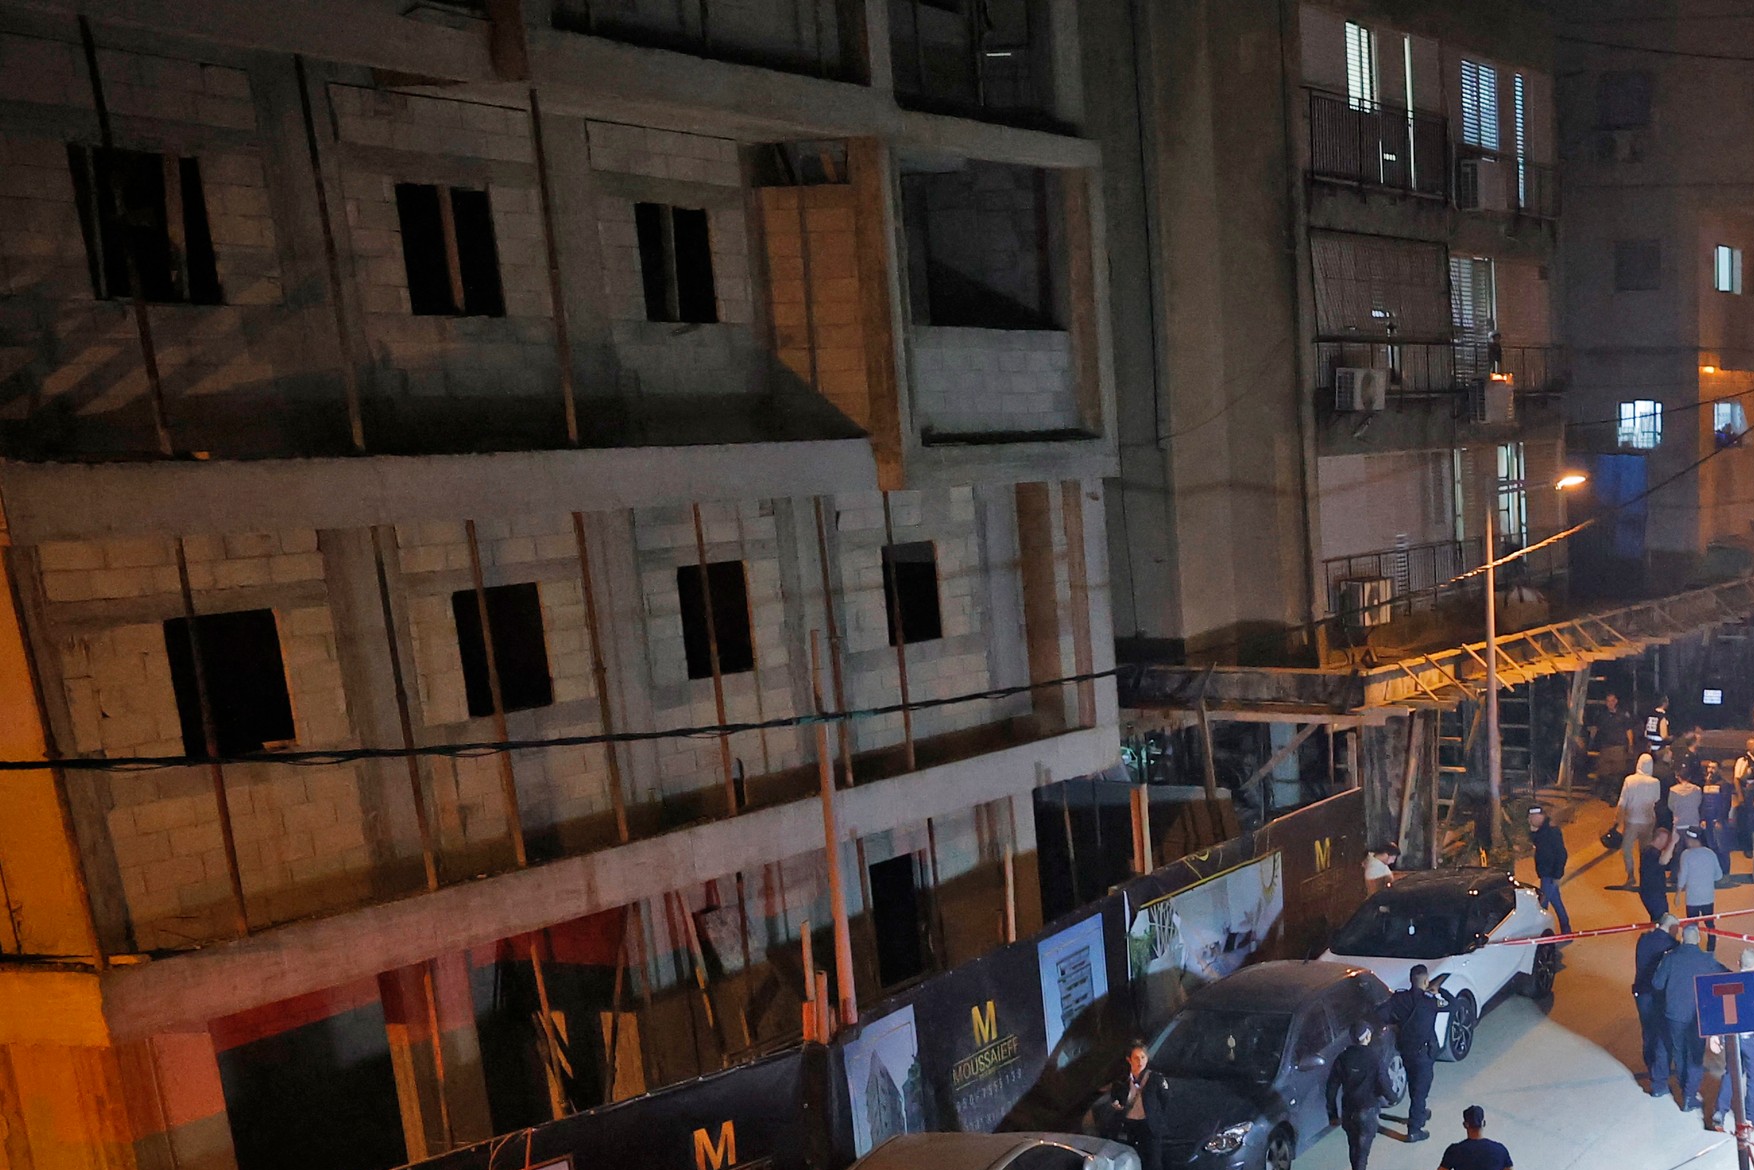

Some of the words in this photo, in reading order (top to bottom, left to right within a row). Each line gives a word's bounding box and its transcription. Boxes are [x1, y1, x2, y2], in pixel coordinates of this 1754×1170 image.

[1314, 837, 1331, 872] M
[971, 1001, 998, 1047] M
[952, 1036, 1020, 1085] MOUSSAIEFF
